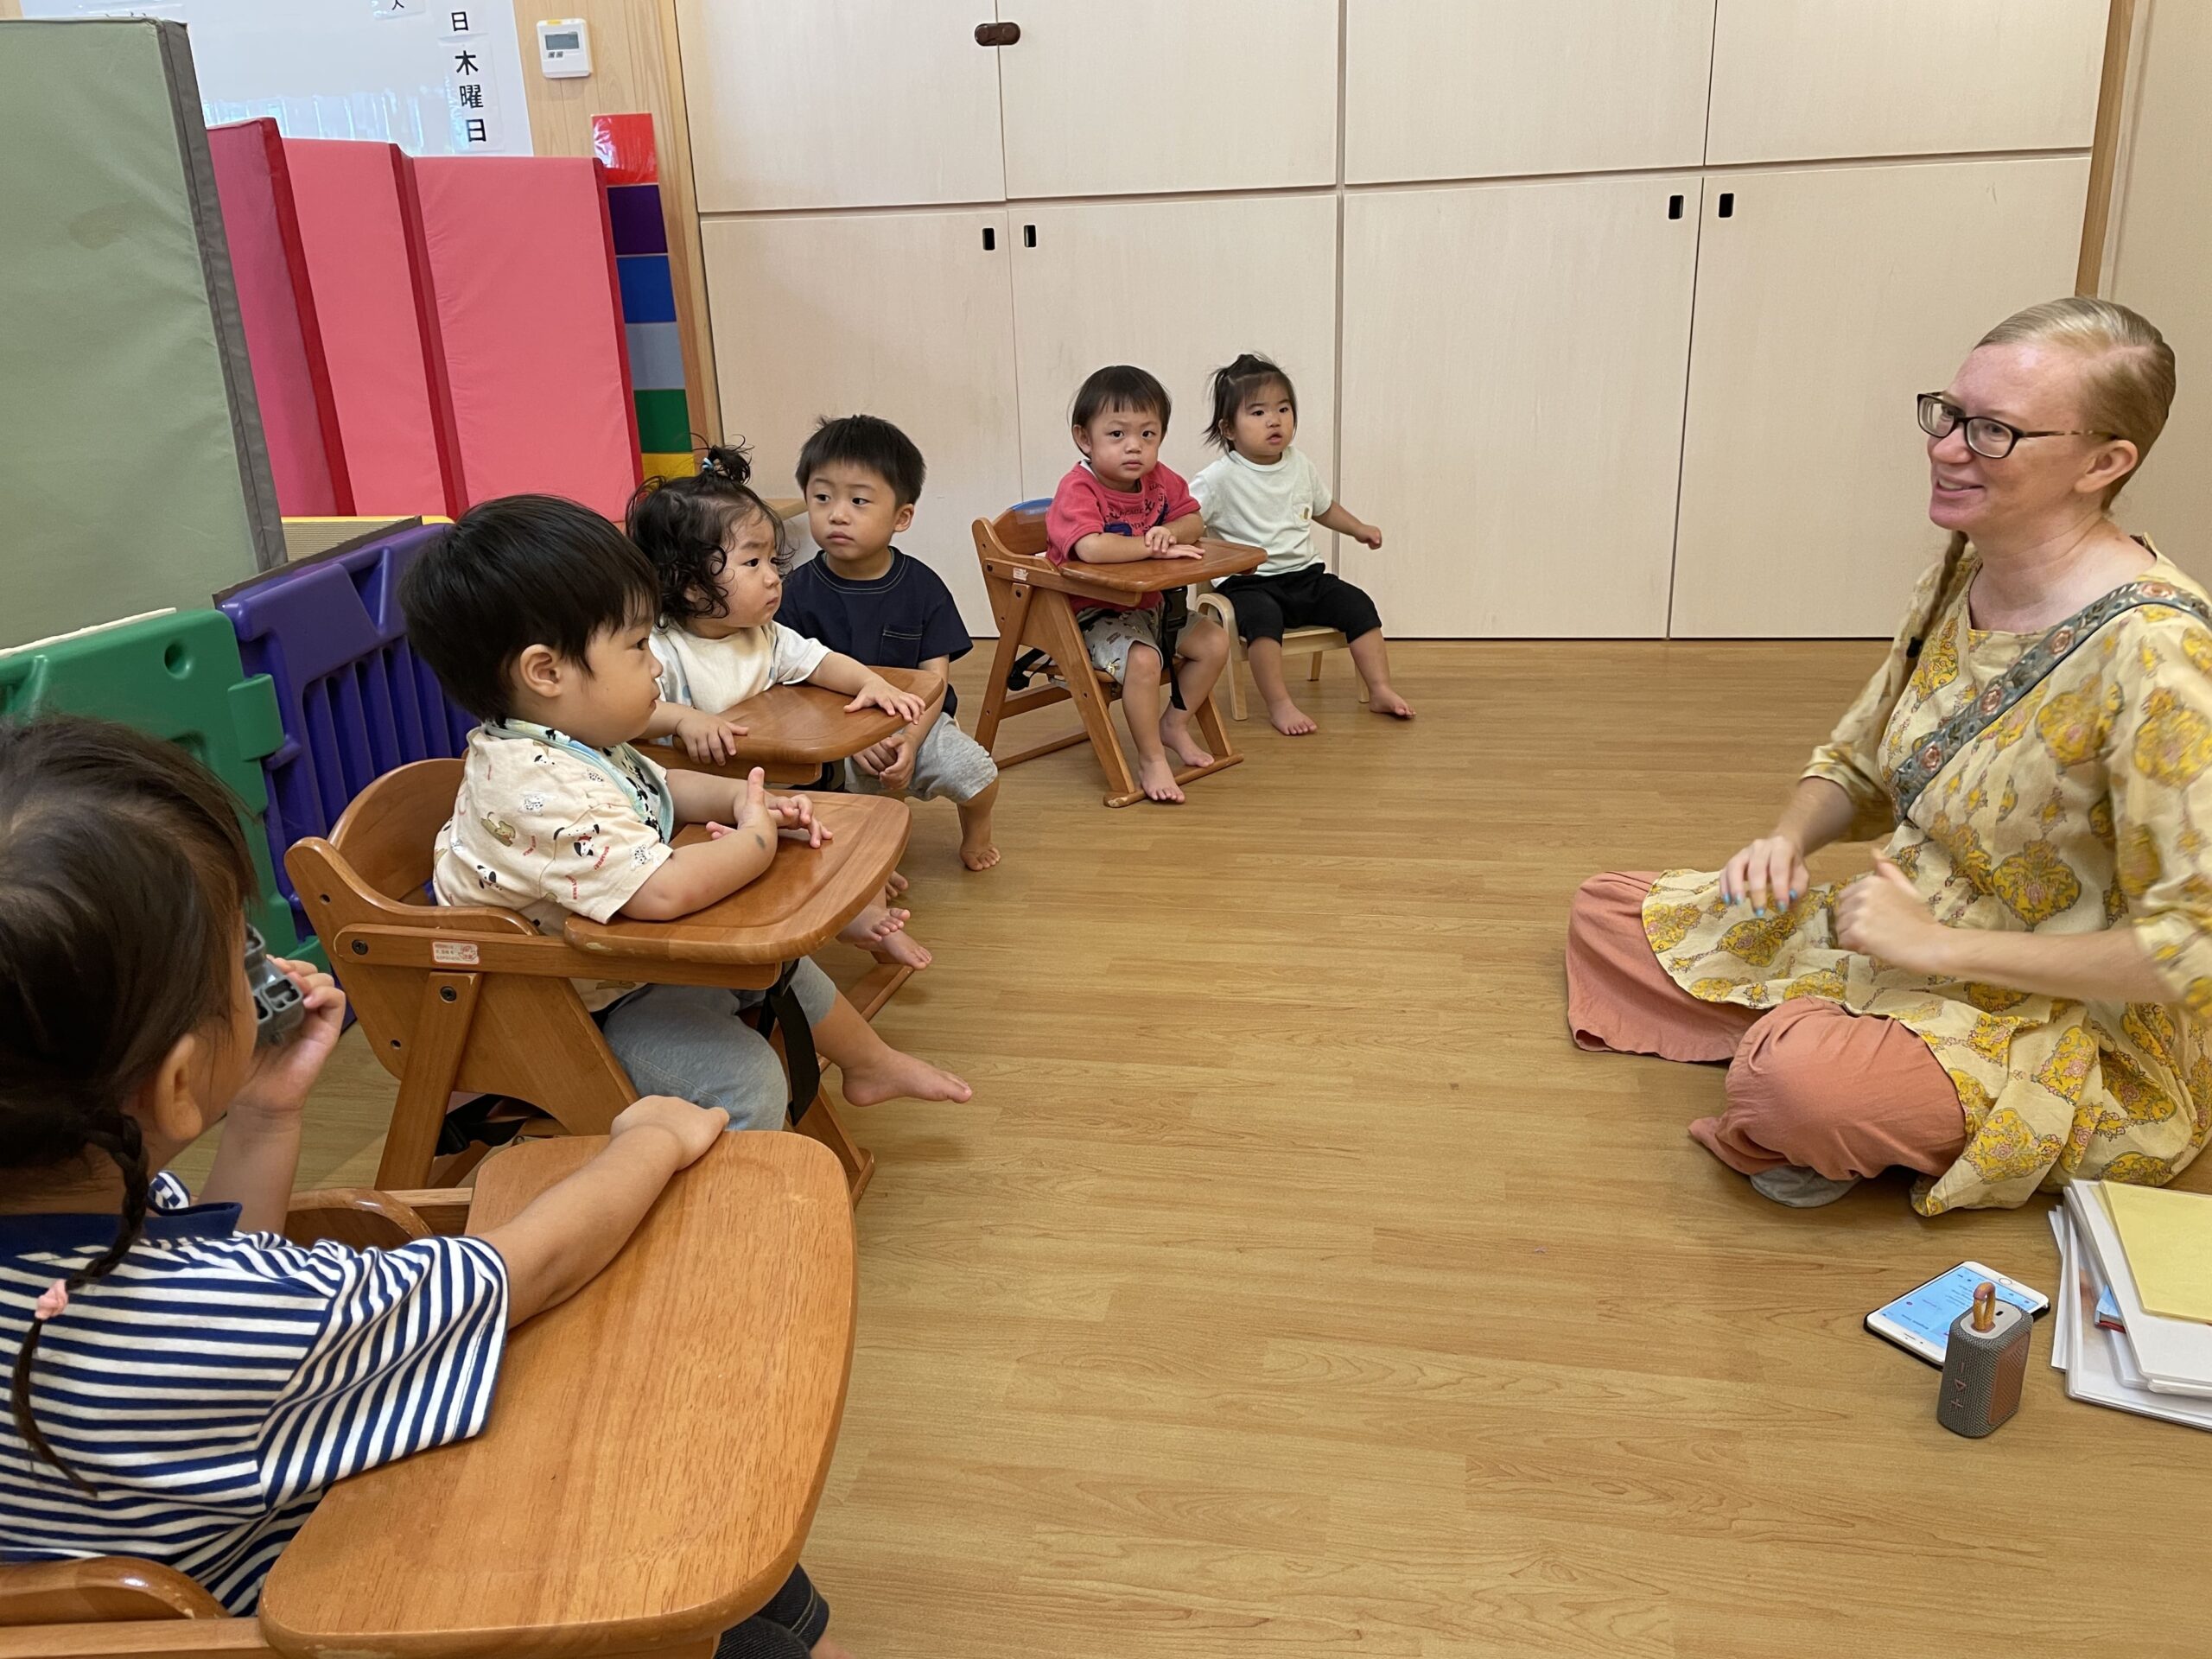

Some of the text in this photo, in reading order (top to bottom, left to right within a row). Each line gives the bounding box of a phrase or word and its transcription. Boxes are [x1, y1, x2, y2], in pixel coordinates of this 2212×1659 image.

[451, 11, 469, 32] 日
[454, 50, 487, 143] 木曜日
